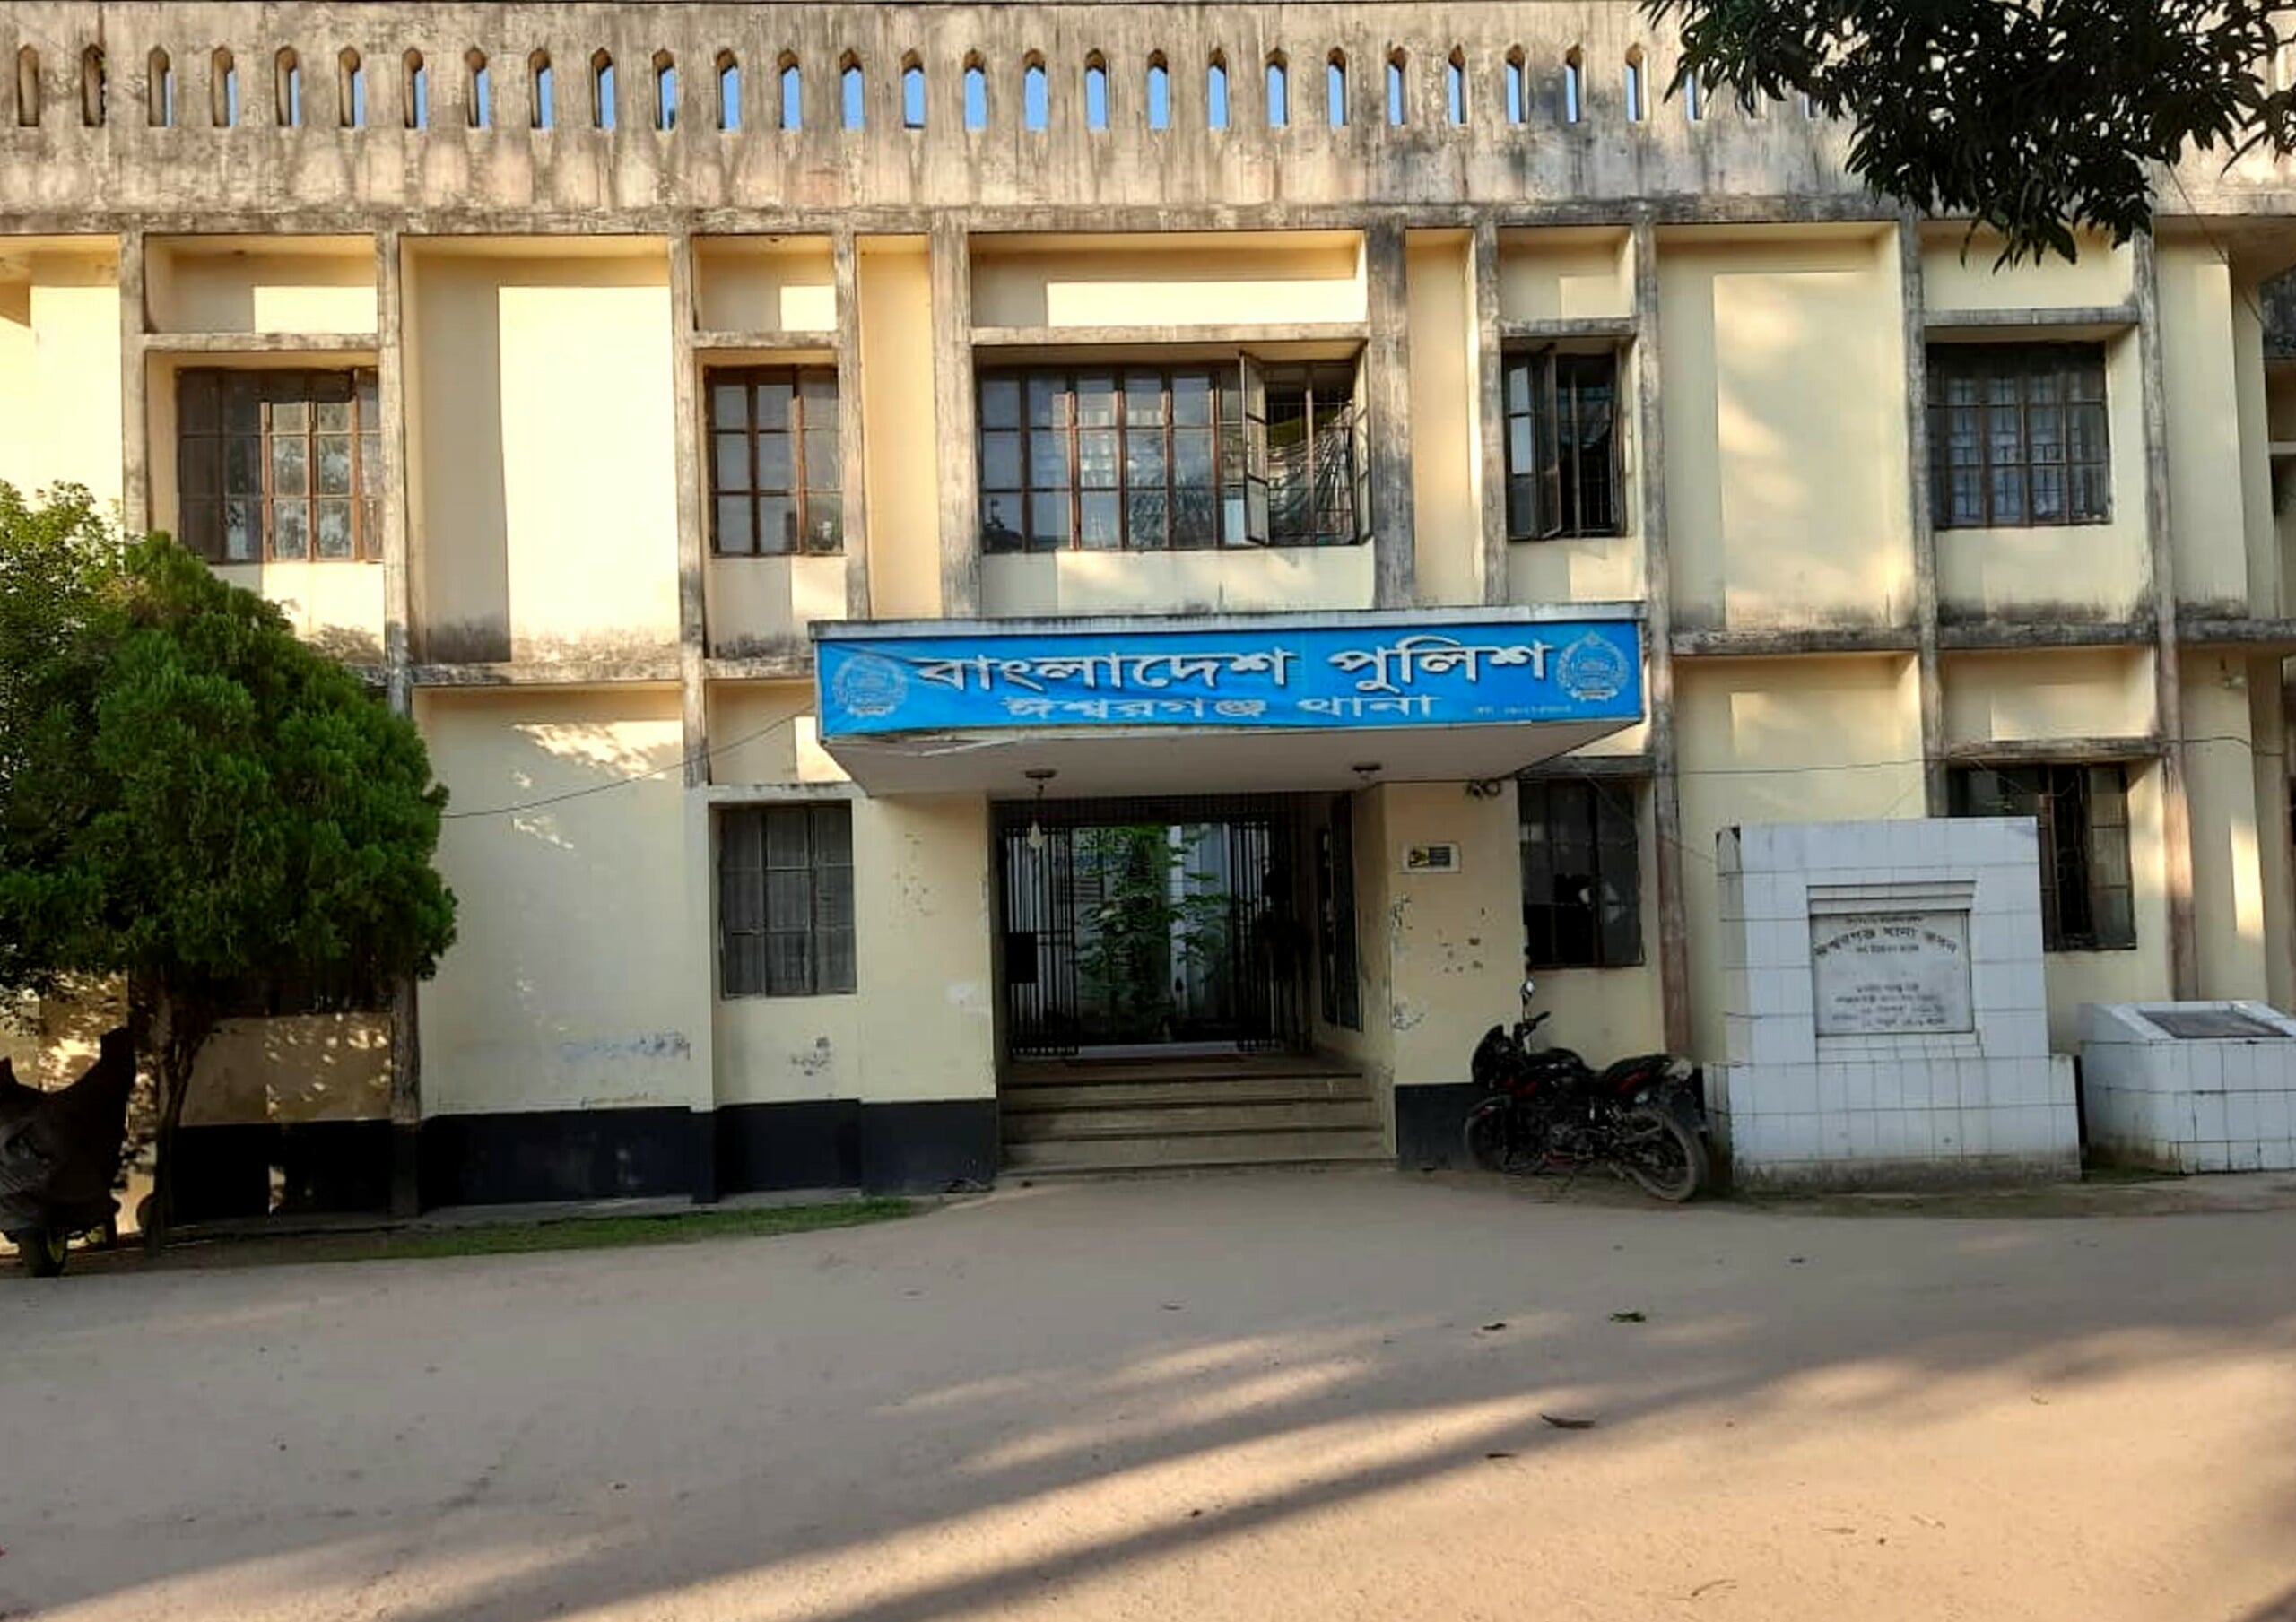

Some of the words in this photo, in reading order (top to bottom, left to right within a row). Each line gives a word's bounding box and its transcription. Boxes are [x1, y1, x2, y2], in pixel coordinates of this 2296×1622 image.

[908, 646, 1299, 692] বাংলাদেশ
[1327, 635, 1554, 694] পুলিশ
[999, 696, 1267, 718] ঈশ্বরগঞ্জ
[1297, 694, 1442, 717] থানা
